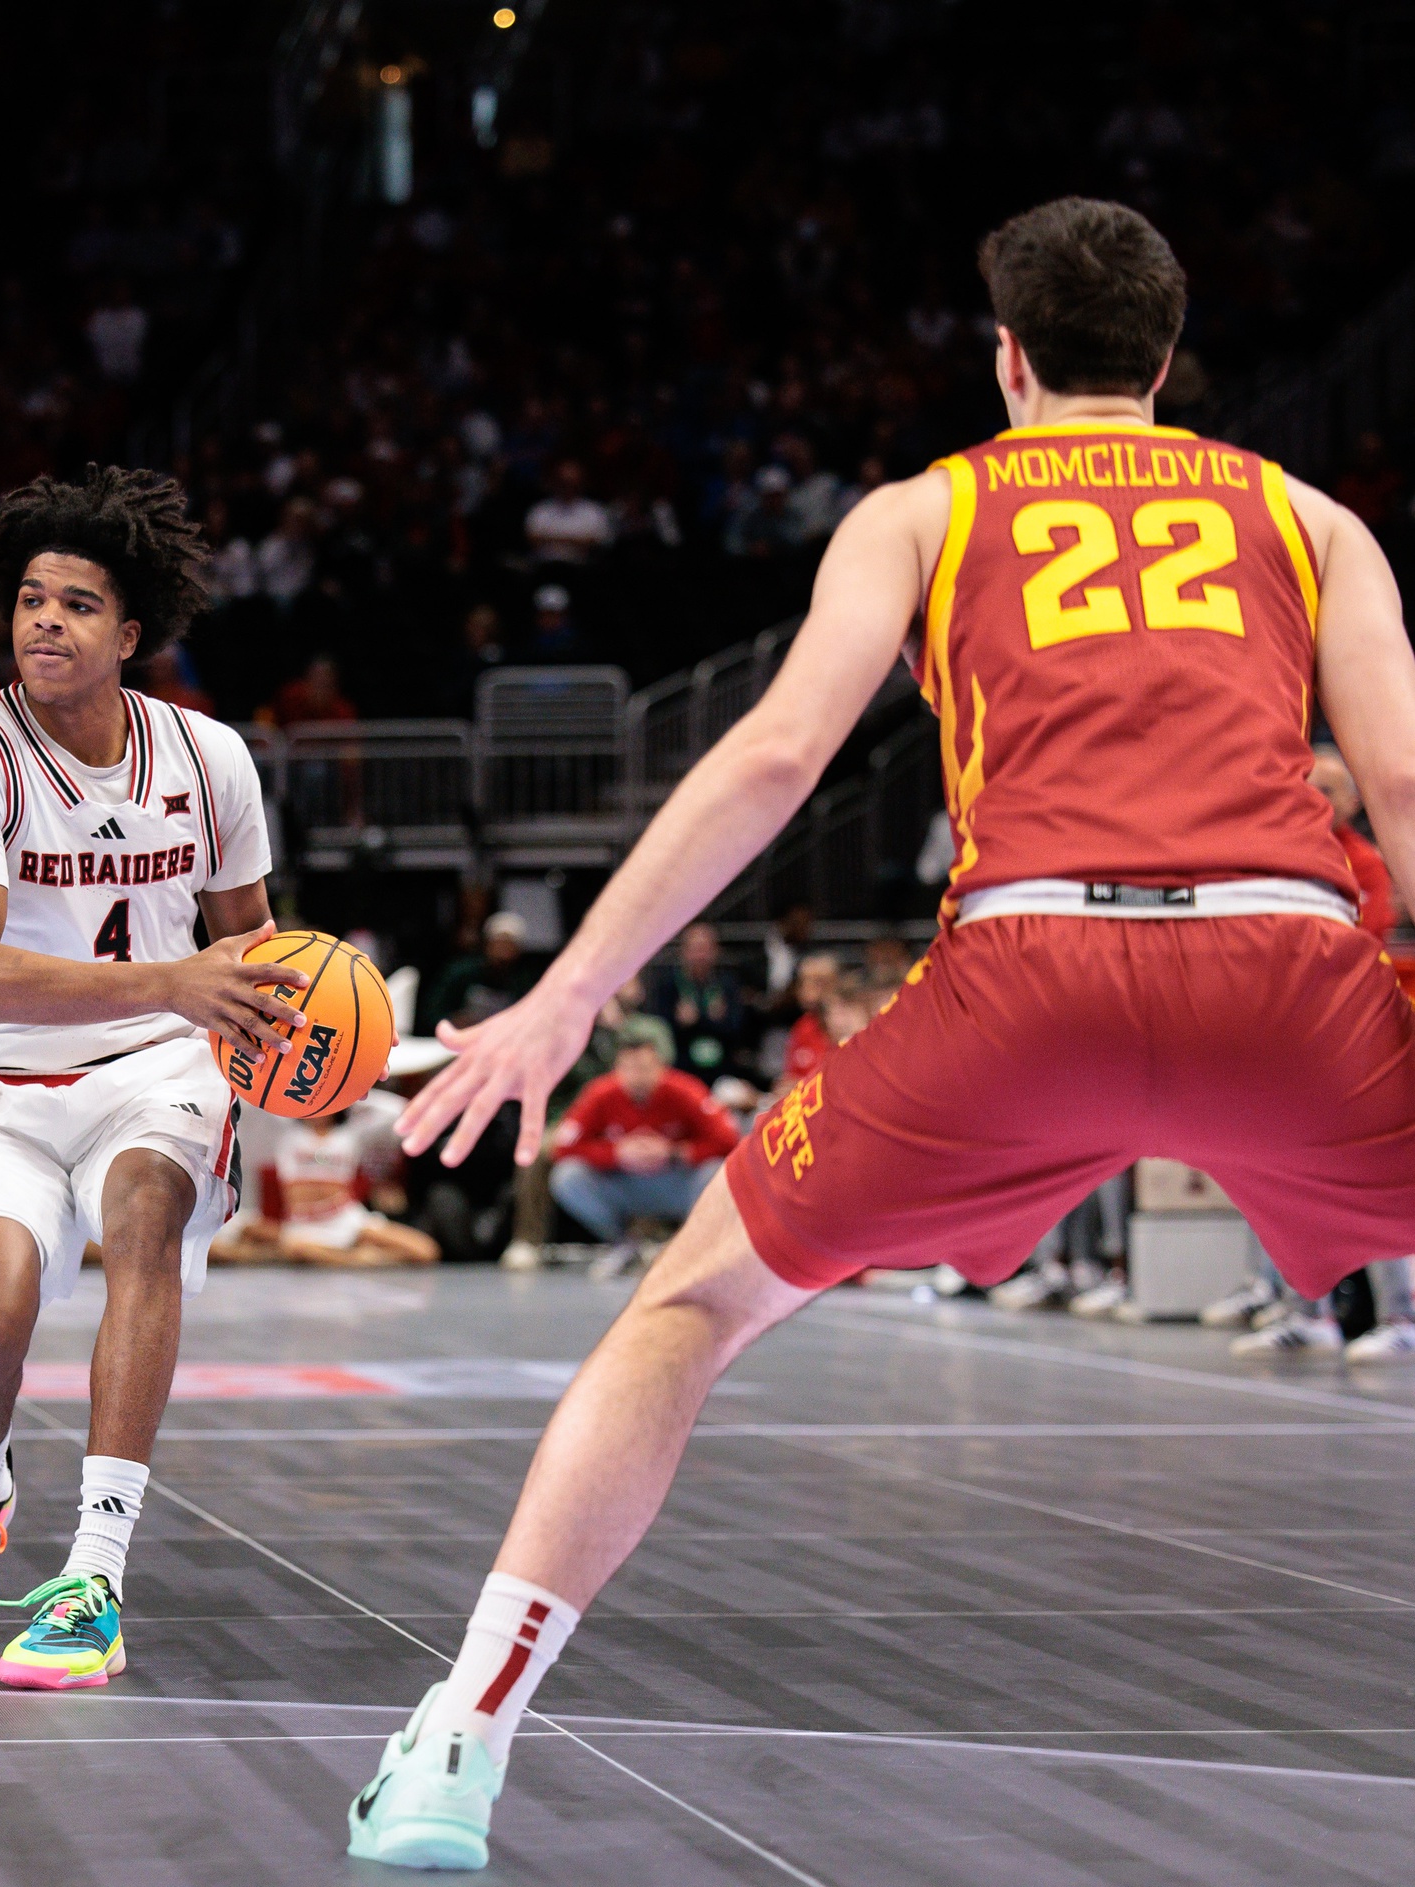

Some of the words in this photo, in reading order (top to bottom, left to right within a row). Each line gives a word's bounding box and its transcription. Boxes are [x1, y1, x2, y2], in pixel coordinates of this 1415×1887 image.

[984, 442, 1249, 491] MOMCILOVIC
[1012, 499, 1245, 651] 22
[19, 850, 74, 887] RED
[78, 843, 195, 886] RAIDERS
[94, 898, 132, 962] 4
[283, 1023, 337, 1104] NCAA
[323, 1056, 336, 1079] GAME
[333, 1031, 345, 1054] BALL
